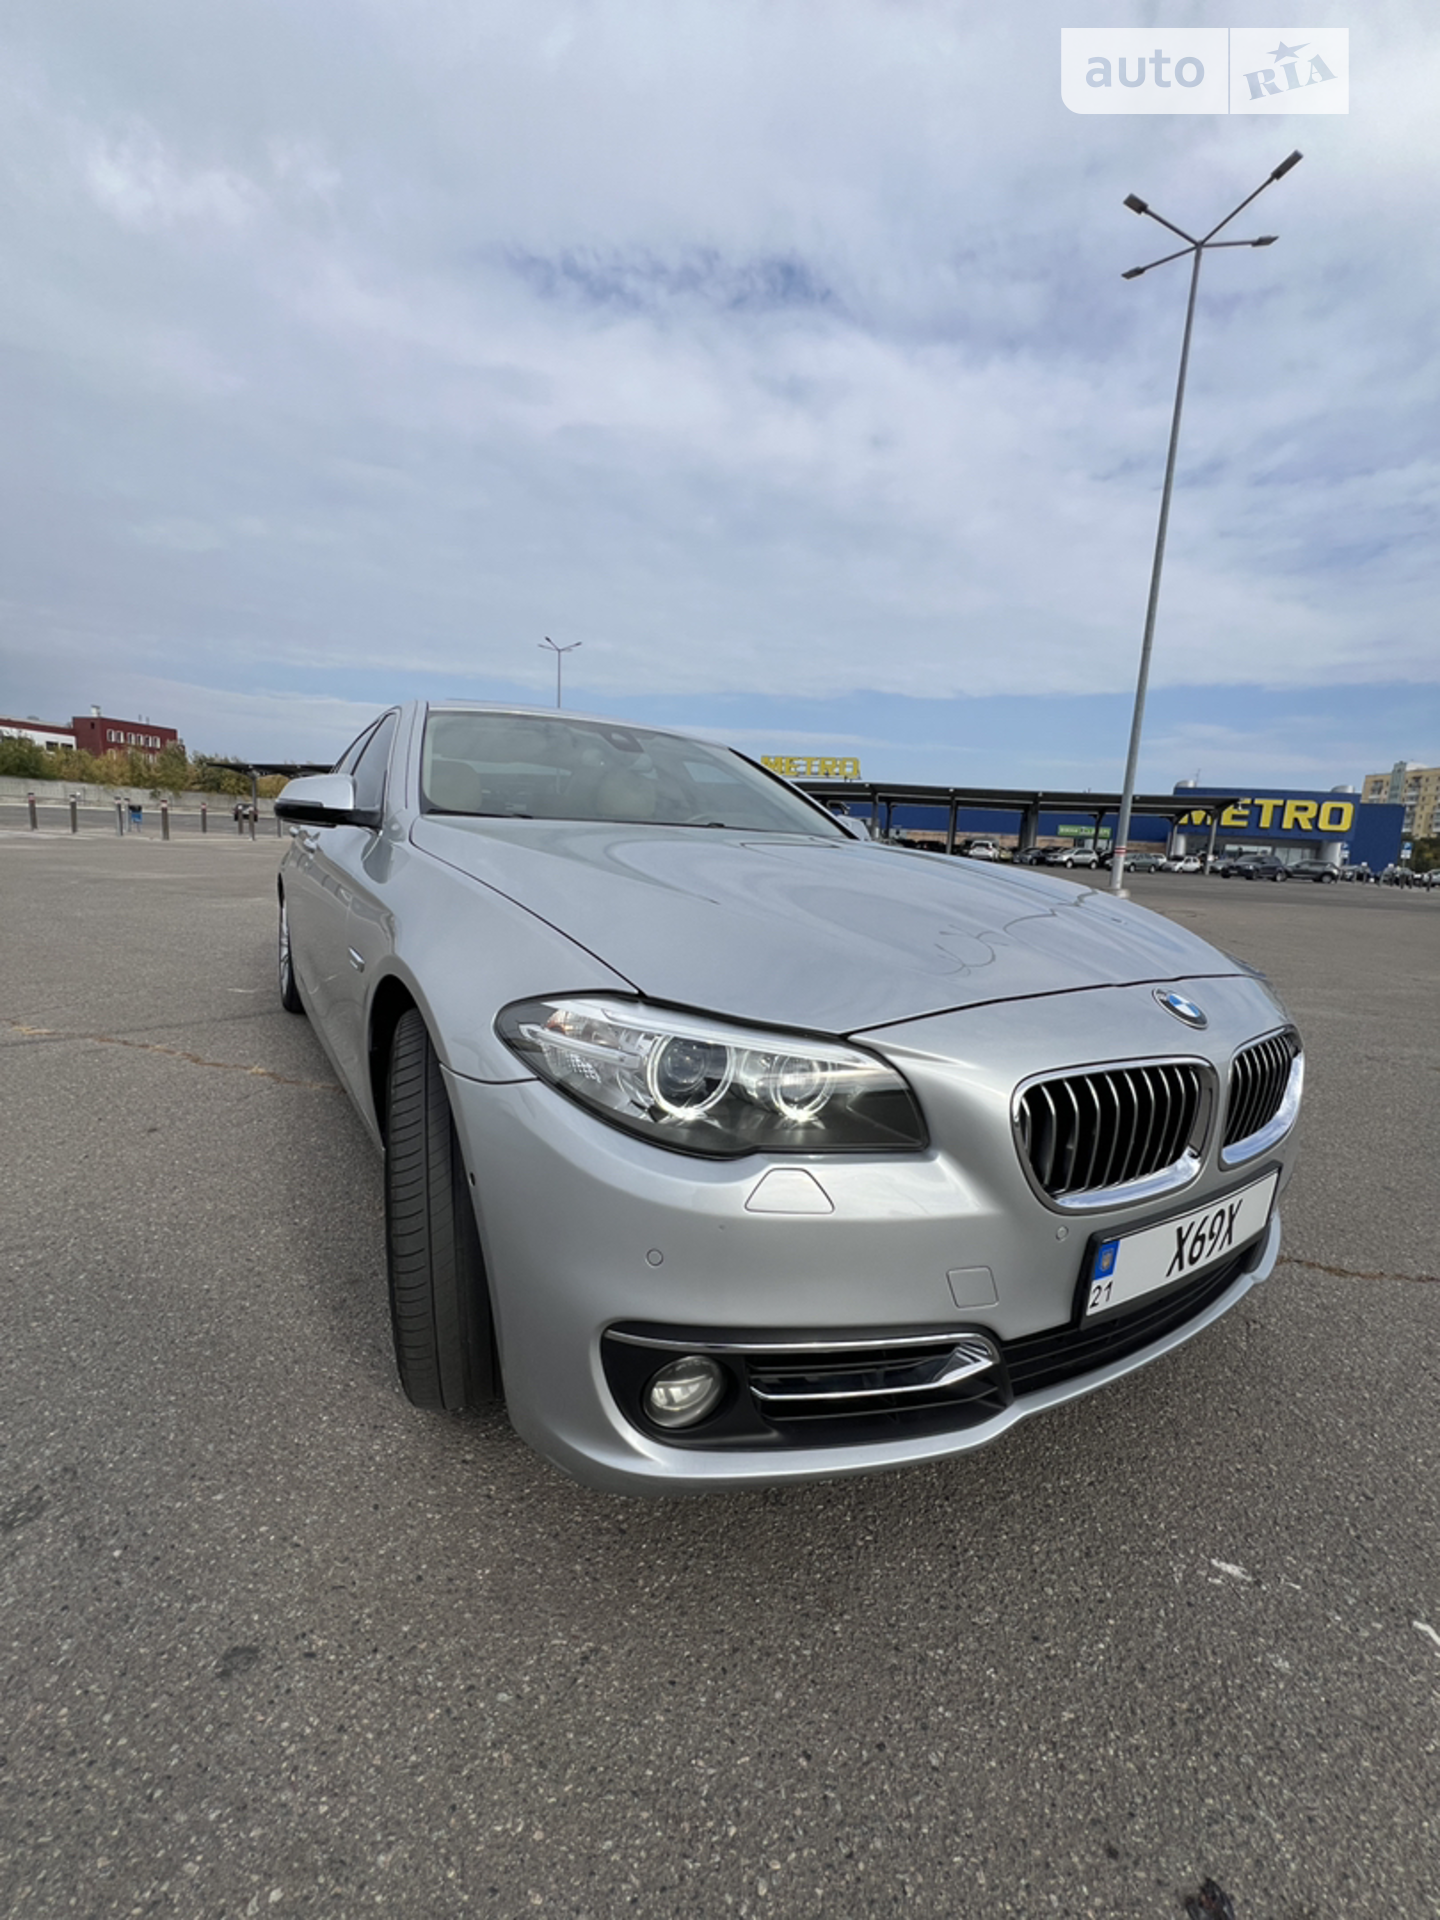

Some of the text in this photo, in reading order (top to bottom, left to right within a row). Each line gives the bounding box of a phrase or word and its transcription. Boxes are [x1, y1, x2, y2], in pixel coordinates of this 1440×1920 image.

[761, 756, 860, 779] METRO
[1165, 1198, 1244, 1278] X69X
[1089, 1280, 1114, 1309] 21
